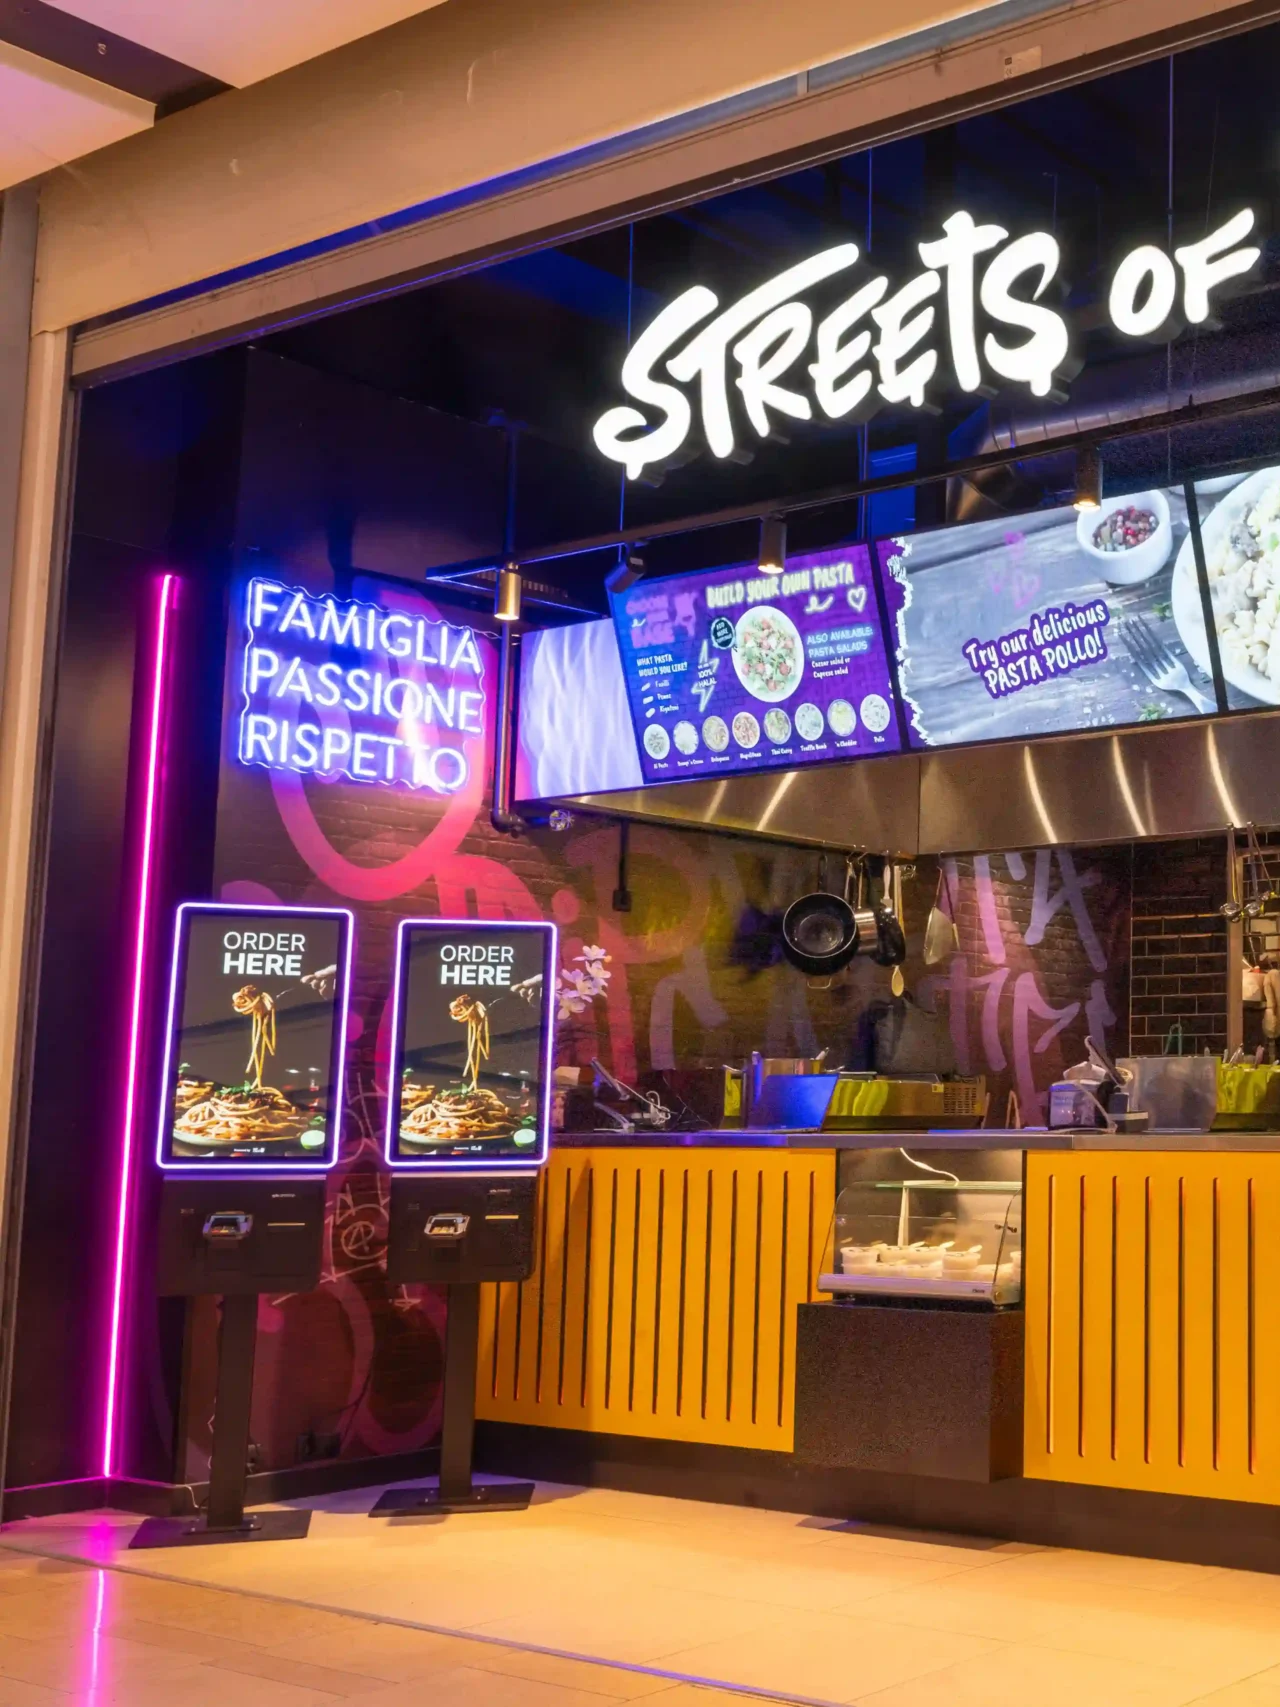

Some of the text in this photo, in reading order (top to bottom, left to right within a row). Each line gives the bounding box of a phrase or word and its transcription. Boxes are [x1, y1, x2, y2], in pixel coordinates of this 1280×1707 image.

[593, 210, 1069, 480] STREETS
[1108, 208, 1262, 337] OF
[813, 564, 854, 589] PASTA
[253, 583, 481, 674] FAMIGLIA
[807, 633, 828, 645] ALSO
[965, 604, 1106, 669] Try our delicious
[637, 653, 672, 666] WHAT PASTA
[809, 642, 868, 659] PASTA SALADS
[984, 627, 1104, 695] PASTA POLLO!
[250, 647, 483, 733] PASSIONE
[246, 714, 467, 789] RISPETTO
[223, 931, 306, 953] ORDER
[440, 944, 514, 964] ORDER
[223, 952, 302, 976] HERE
[440, 964, 511, 986] HERE
